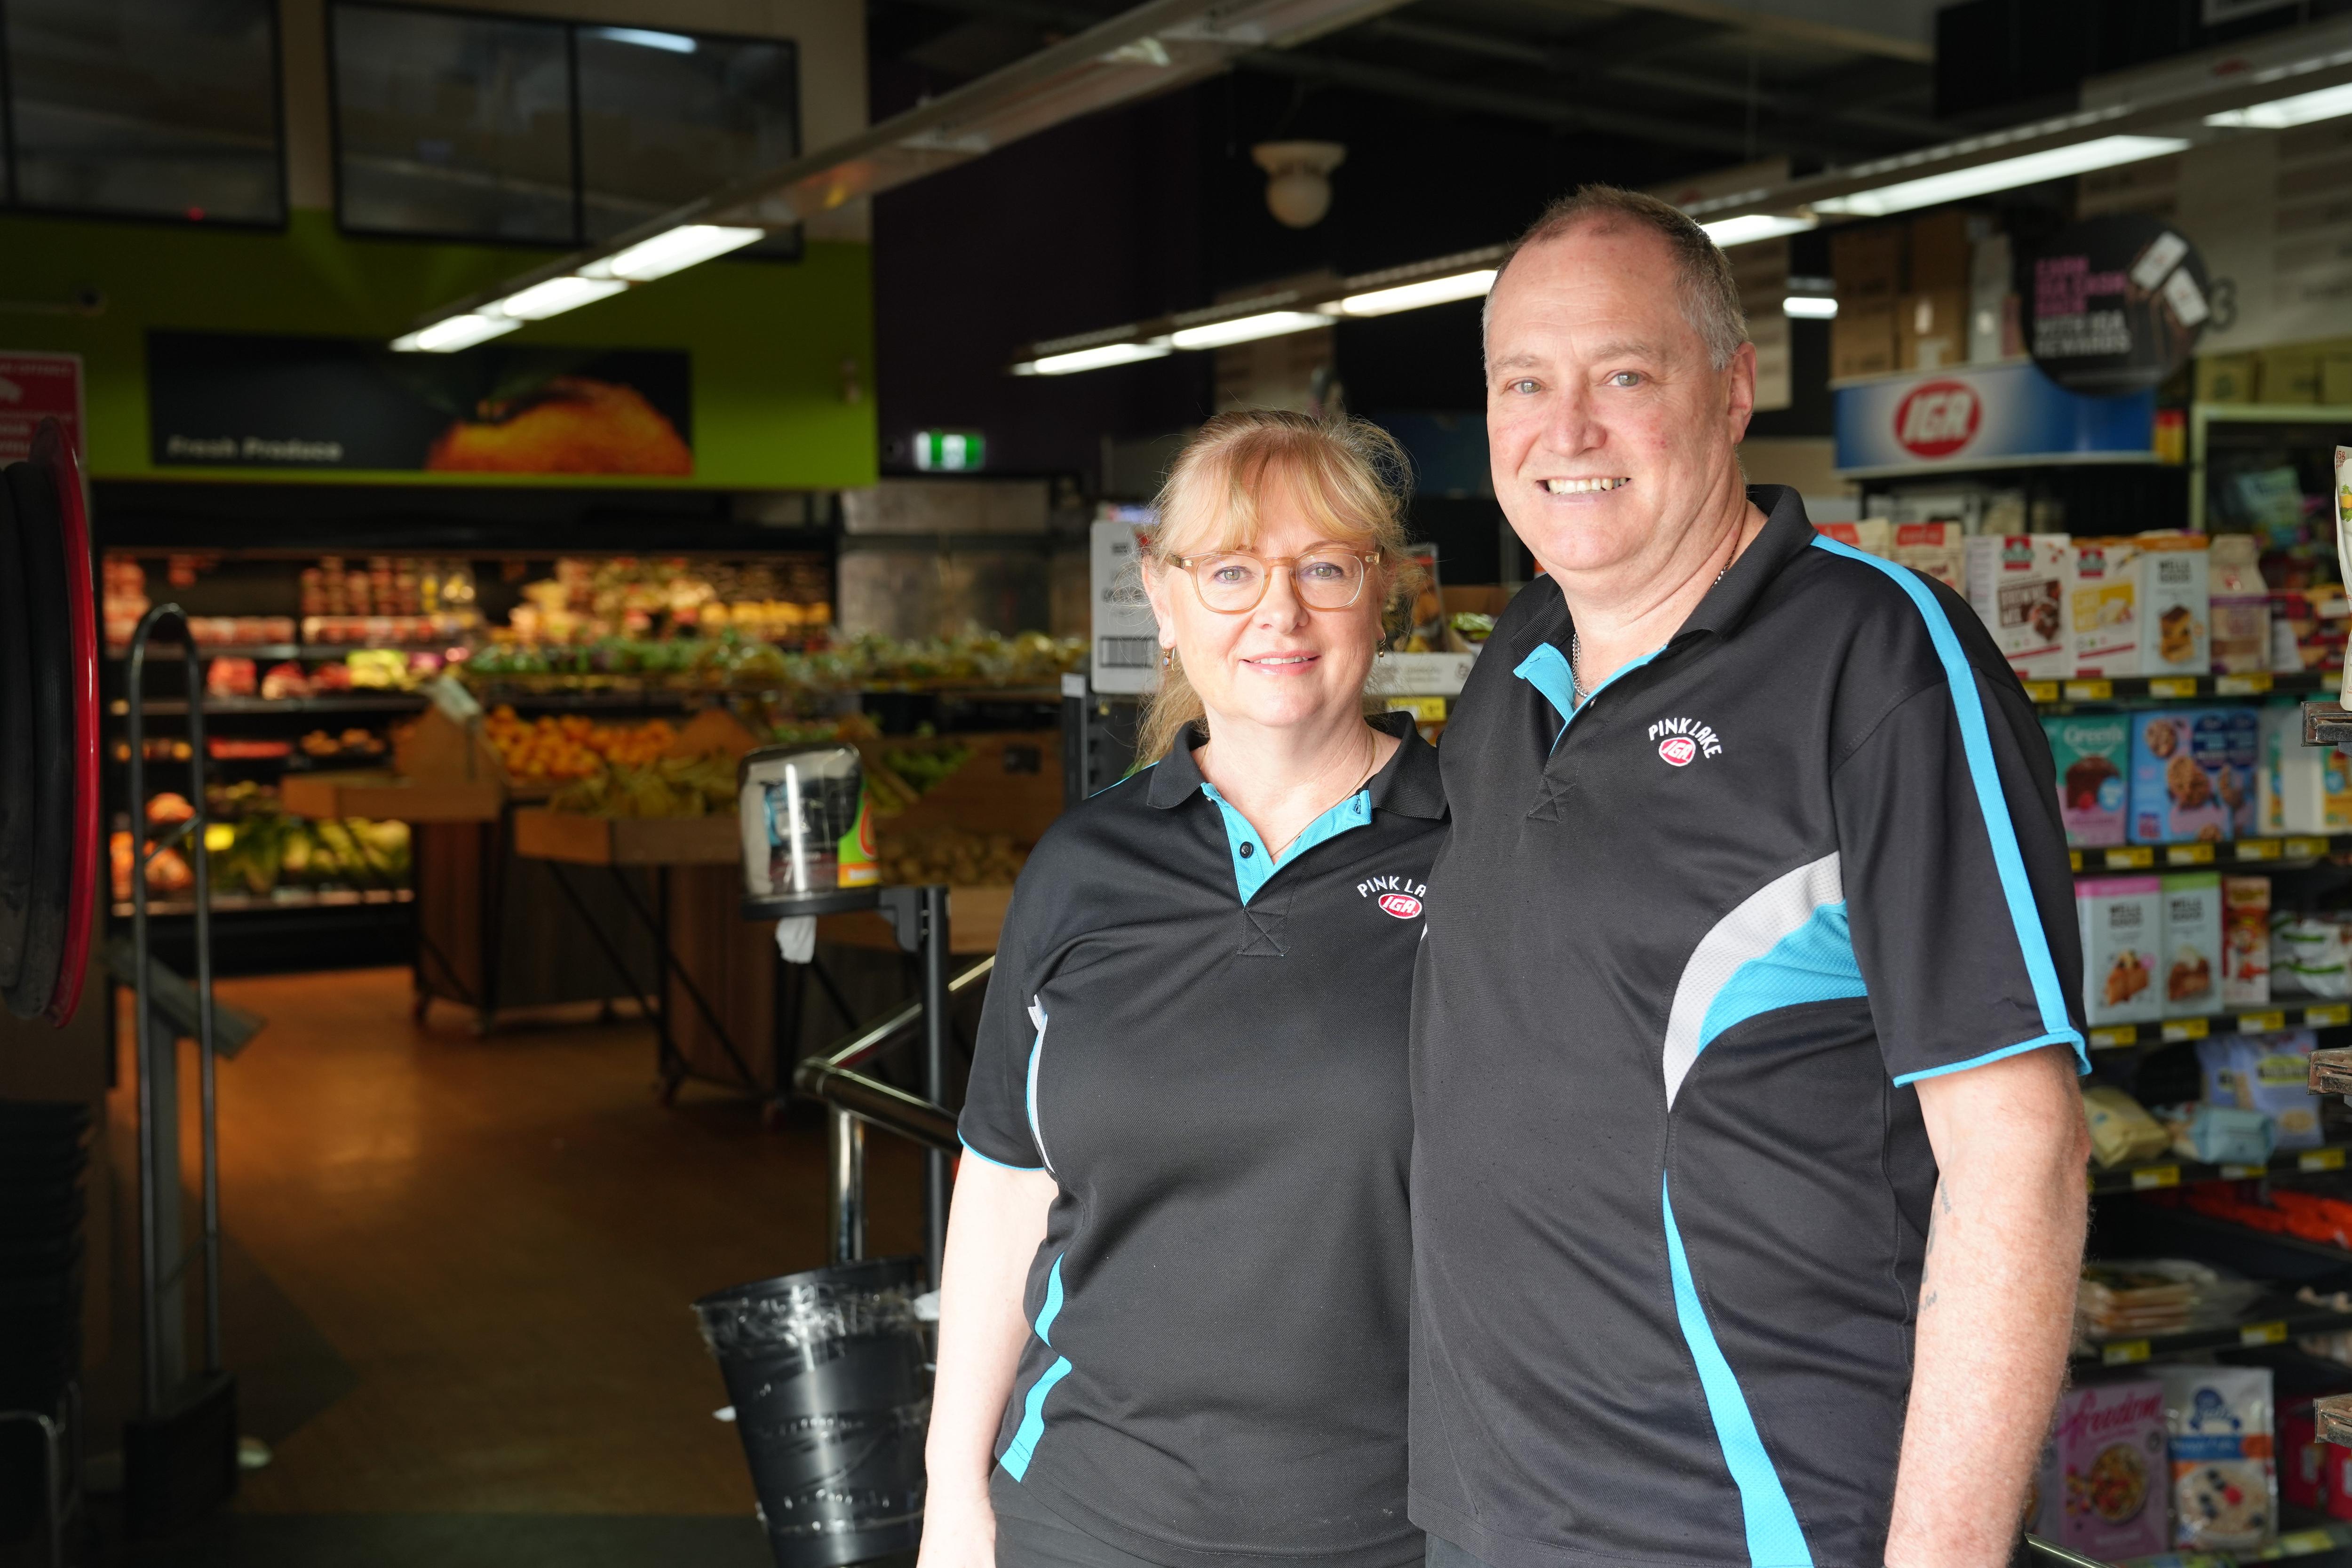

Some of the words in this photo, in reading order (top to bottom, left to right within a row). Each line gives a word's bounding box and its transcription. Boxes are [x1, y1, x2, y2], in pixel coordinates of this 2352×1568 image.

[1903, 393, 1970, 443] IGA
[167, 434, 238, 459] Fresh
[242, 436, 343, 462] Produce
[1648, 717, 1692, 741] PINK
[1687, 721, 1722, 759] LAKE
[1661, 740, 1693, 760] IGA
[1357, 876, 1400, 898] PINK
[1404, 878, 1427, 898] LA
[1382, 896, 1416, 914] IGA
